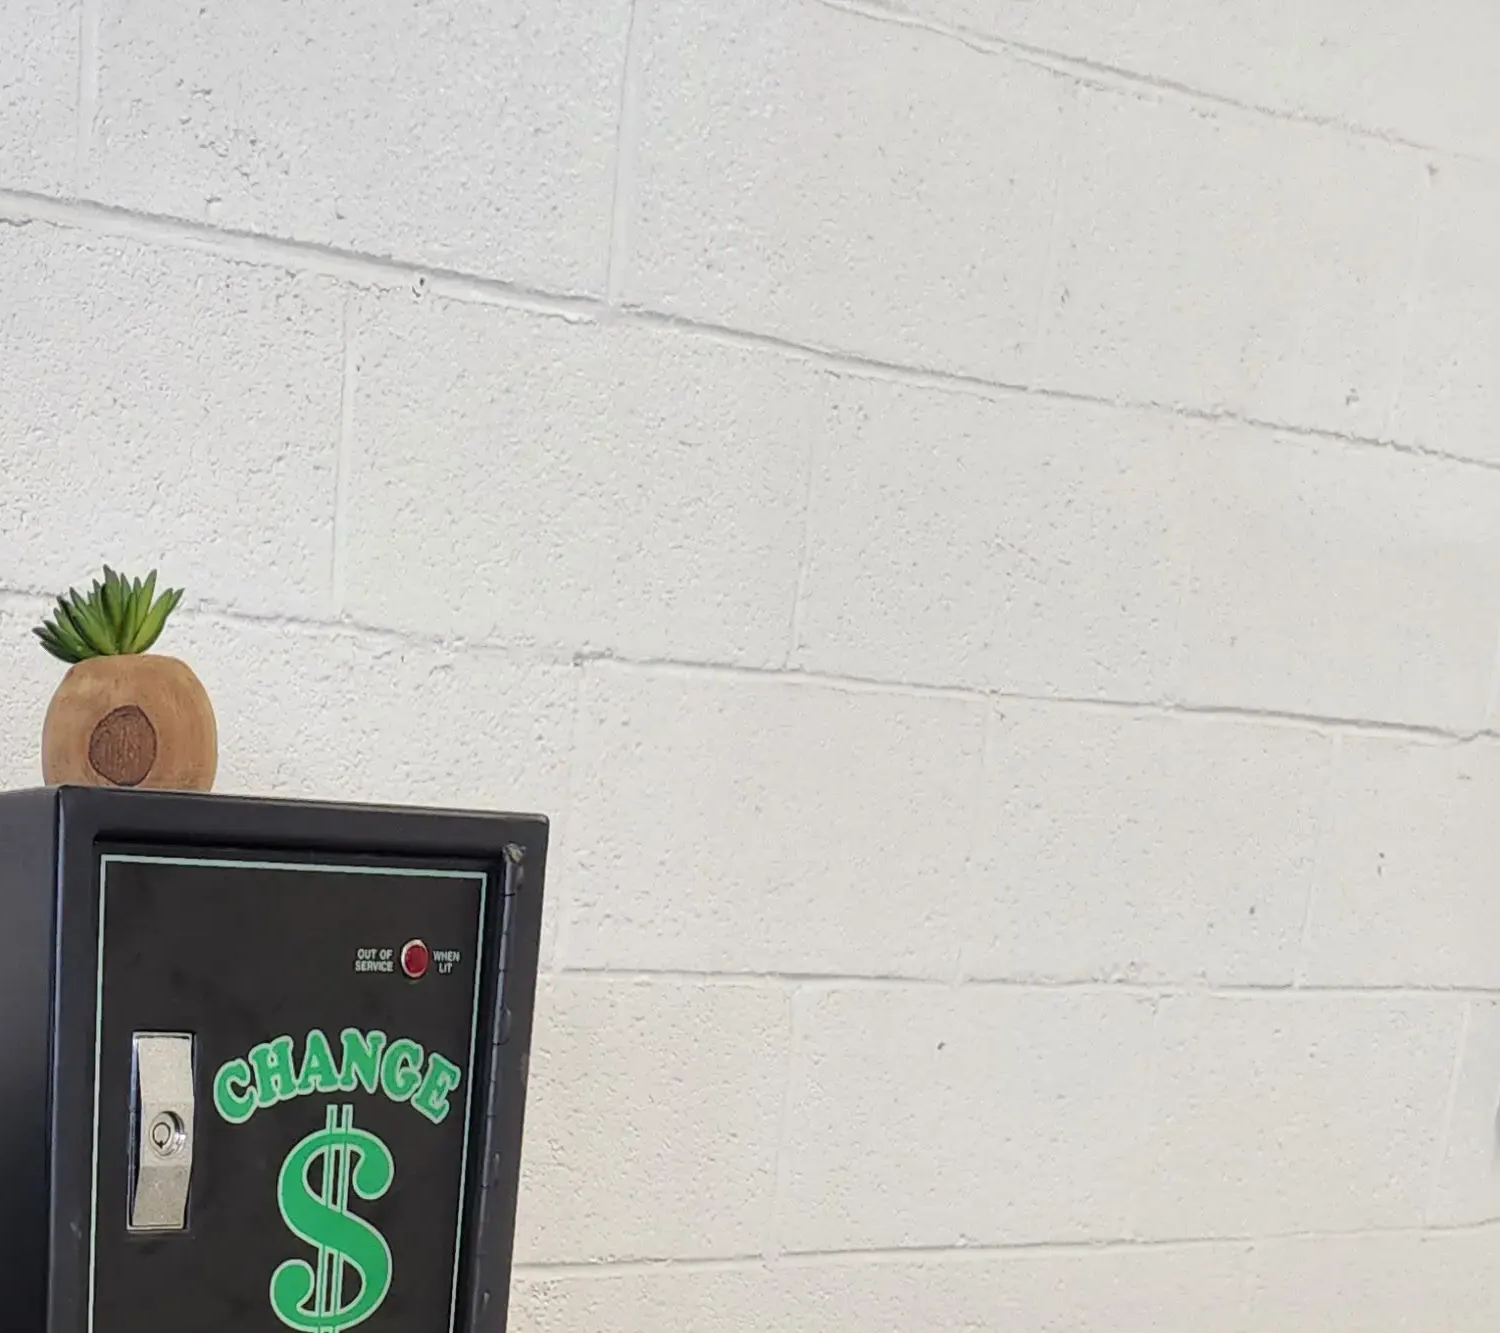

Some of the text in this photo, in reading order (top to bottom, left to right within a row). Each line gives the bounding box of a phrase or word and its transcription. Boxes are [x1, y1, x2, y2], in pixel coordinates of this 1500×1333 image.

[357, 948, 393, 960] OUT OF
[432, 951, 461, 963] WHEN
[355, 960, 394, 972] SERVICE
[438, 962, 453, 974] LIT
[213, 1027, 462, 1124] CHANGE
